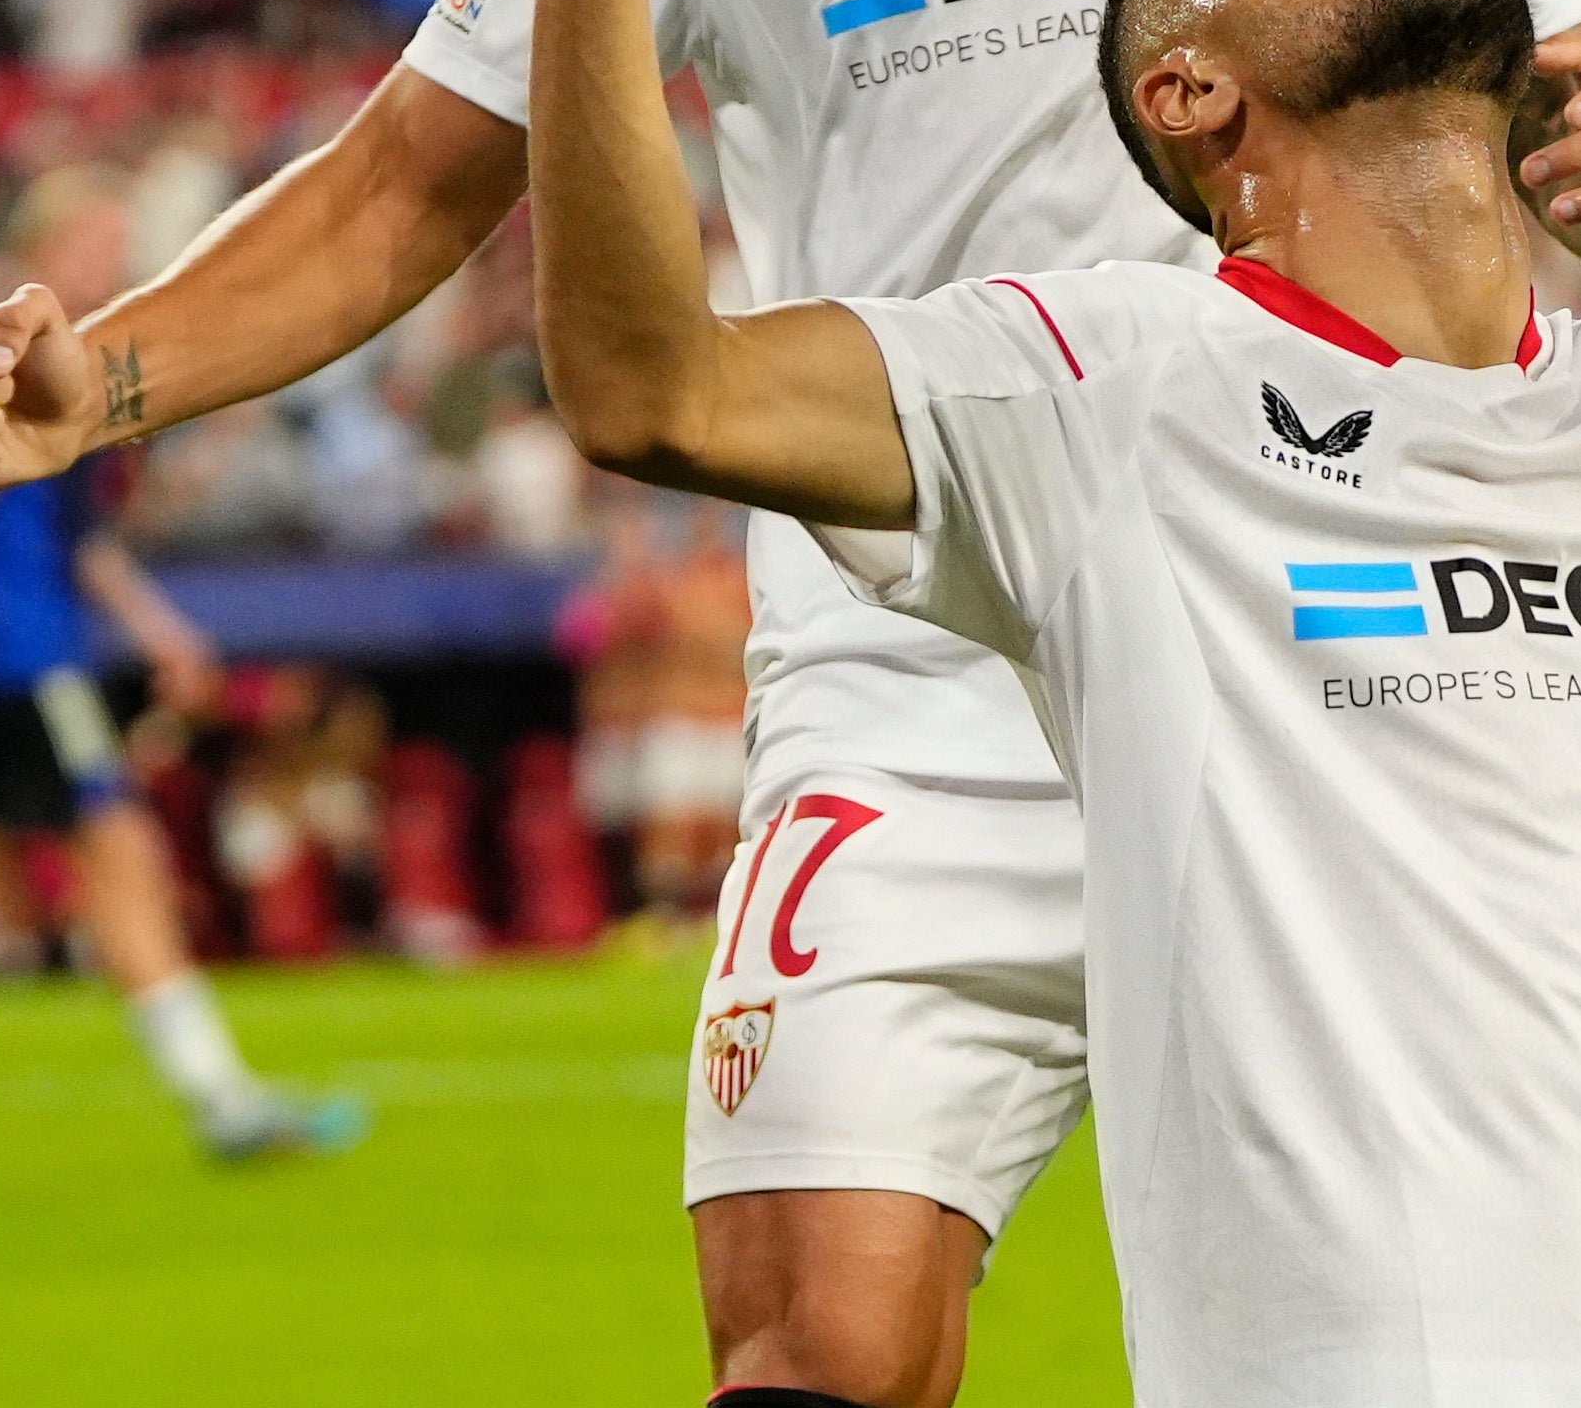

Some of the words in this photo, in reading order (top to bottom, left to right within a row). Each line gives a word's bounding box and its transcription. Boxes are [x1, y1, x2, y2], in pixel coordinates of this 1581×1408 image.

[1017, 8, 1103, 49] LEAD
[1260, 444, 1362, 489] CASTORE
[718, 793, 885, 981] 17
